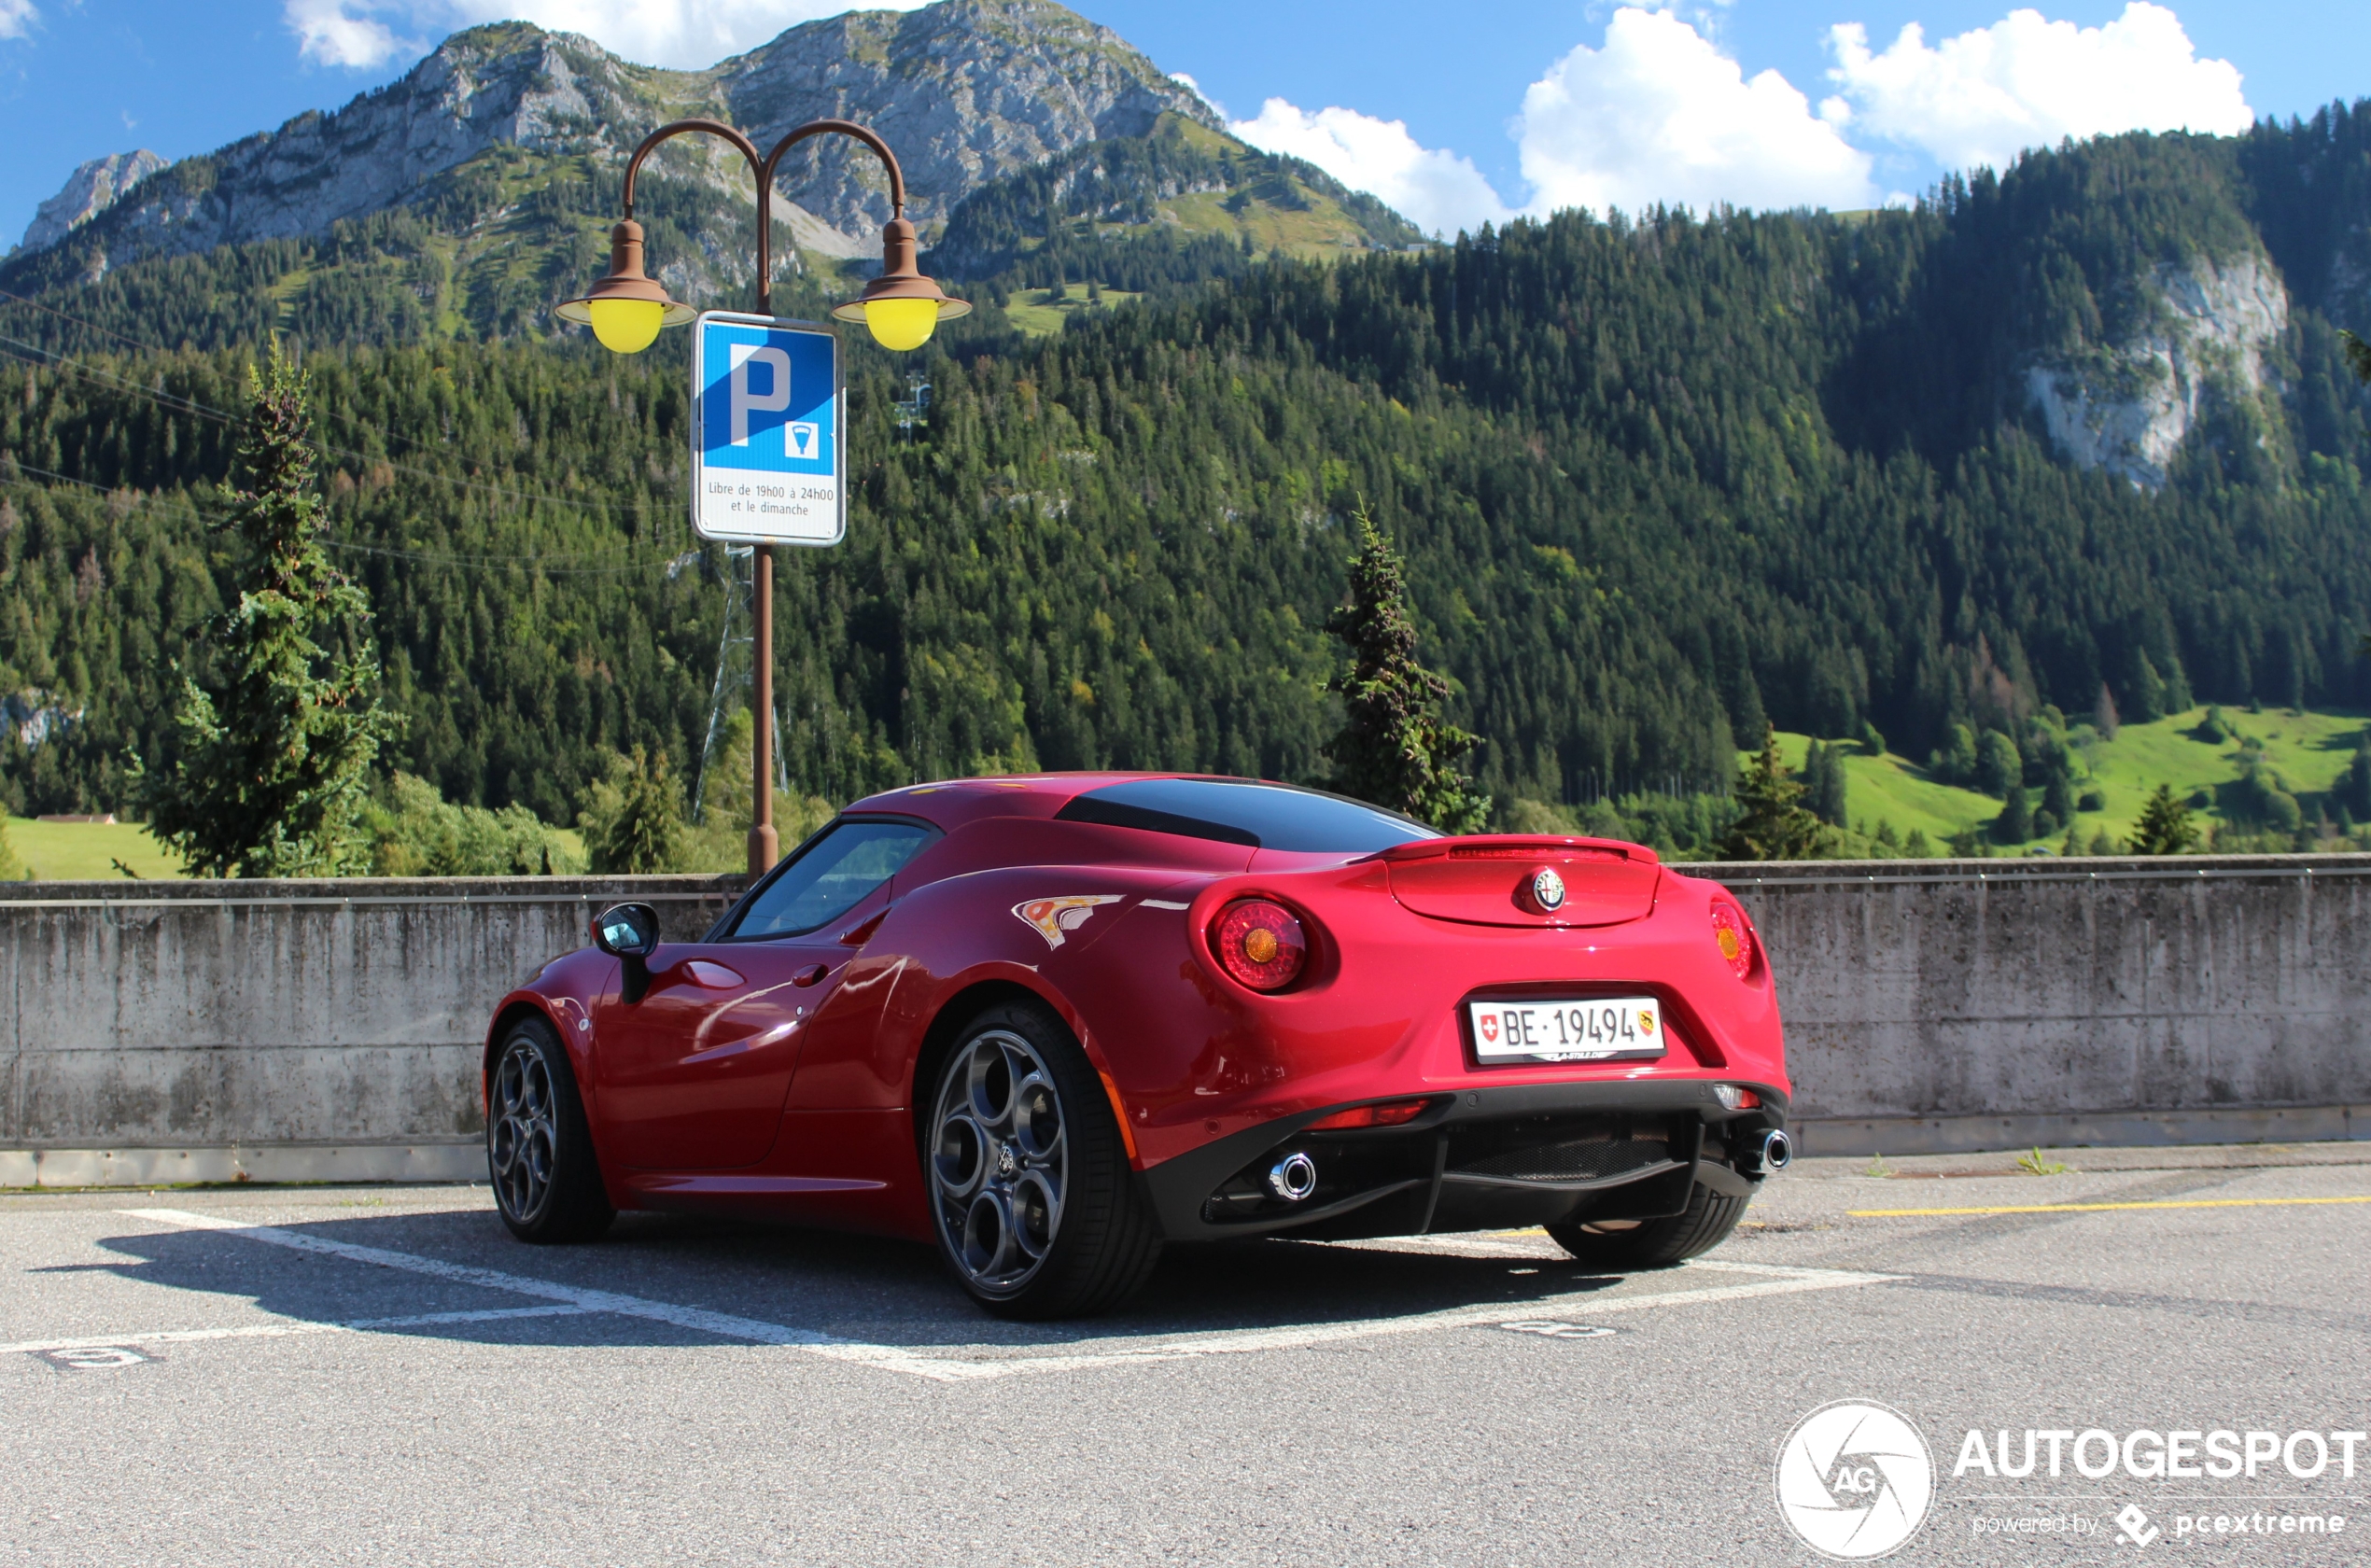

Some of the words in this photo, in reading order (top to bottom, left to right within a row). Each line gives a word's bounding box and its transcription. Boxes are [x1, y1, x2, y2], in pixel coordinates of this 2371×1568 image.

[730, 343, 791, 447] P
[708, 482, 734, 495] Libre
[738, 483, 751, 497] de
[756, 485, 785, 498] 19h00
[790, 487, 796, 499] à
[800, 487, 835, 501] 24h00
[731, 501, 741, 511] et
[746, 500, 755, 512] le
[760, 501, 809, 515] dimanche
